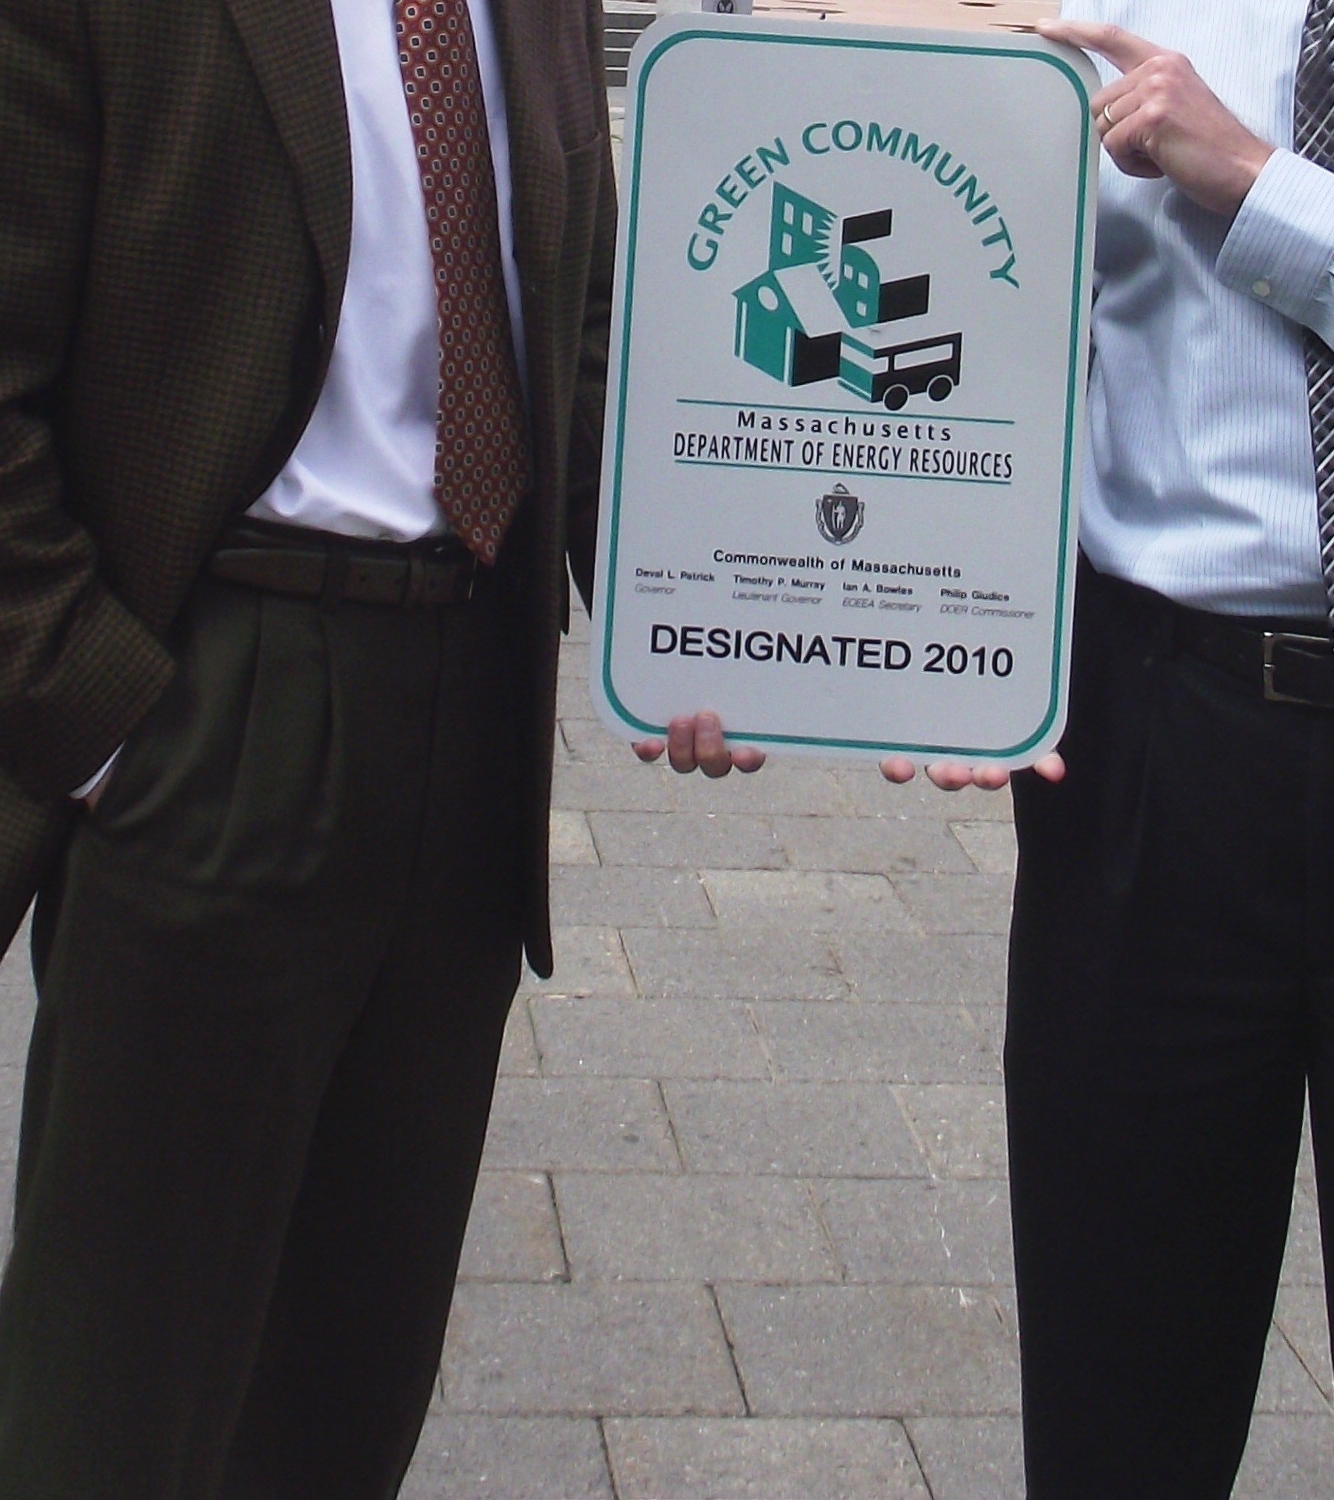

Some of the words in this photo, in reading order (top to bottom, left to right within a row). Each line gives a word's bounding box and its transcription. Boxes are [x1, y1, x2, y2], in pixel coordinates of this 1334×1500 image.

[686, 136, 791, 271] GREEN
[801, 119, 1020, 290] COMMUNITY
[737, 410, 952, 441] Massachusetts
[673, 432, 794, 464] DEPARTMENT
[801, 440, 825, 466] OF
[832, 442, 902, 471] ENERGY
[908, 447, 1013, 478] RESOURCES
[713, 549, 824, 569] Commonwealth
[830, 558, 846, 570] of
[851, 558, 962, 578] Massachusetts
[635, 568, 663, 579] Deval
[680, 571, 715, 582] Patrick
[733, 574, 773, 587] Timothy
[778, 577, 787, 587] P.
[791, 578, 825, 591] Murray
[634, 583, 676, 595] Governor
[842, 581, 858, 591] Ian
[876, 584, 913, 596] Bowles
[940, 588, 967, 600] Philip
[732, 590, 778, 602] Lieutenant
[781, 594, 823, 606] Governor
[879, 599, 922, 613] Secretary
[971, 606, 1035, 619] Commissioner
[650, 623, 912, 671] DESIGNATED
[922, 642, 1014, 678] 2010
